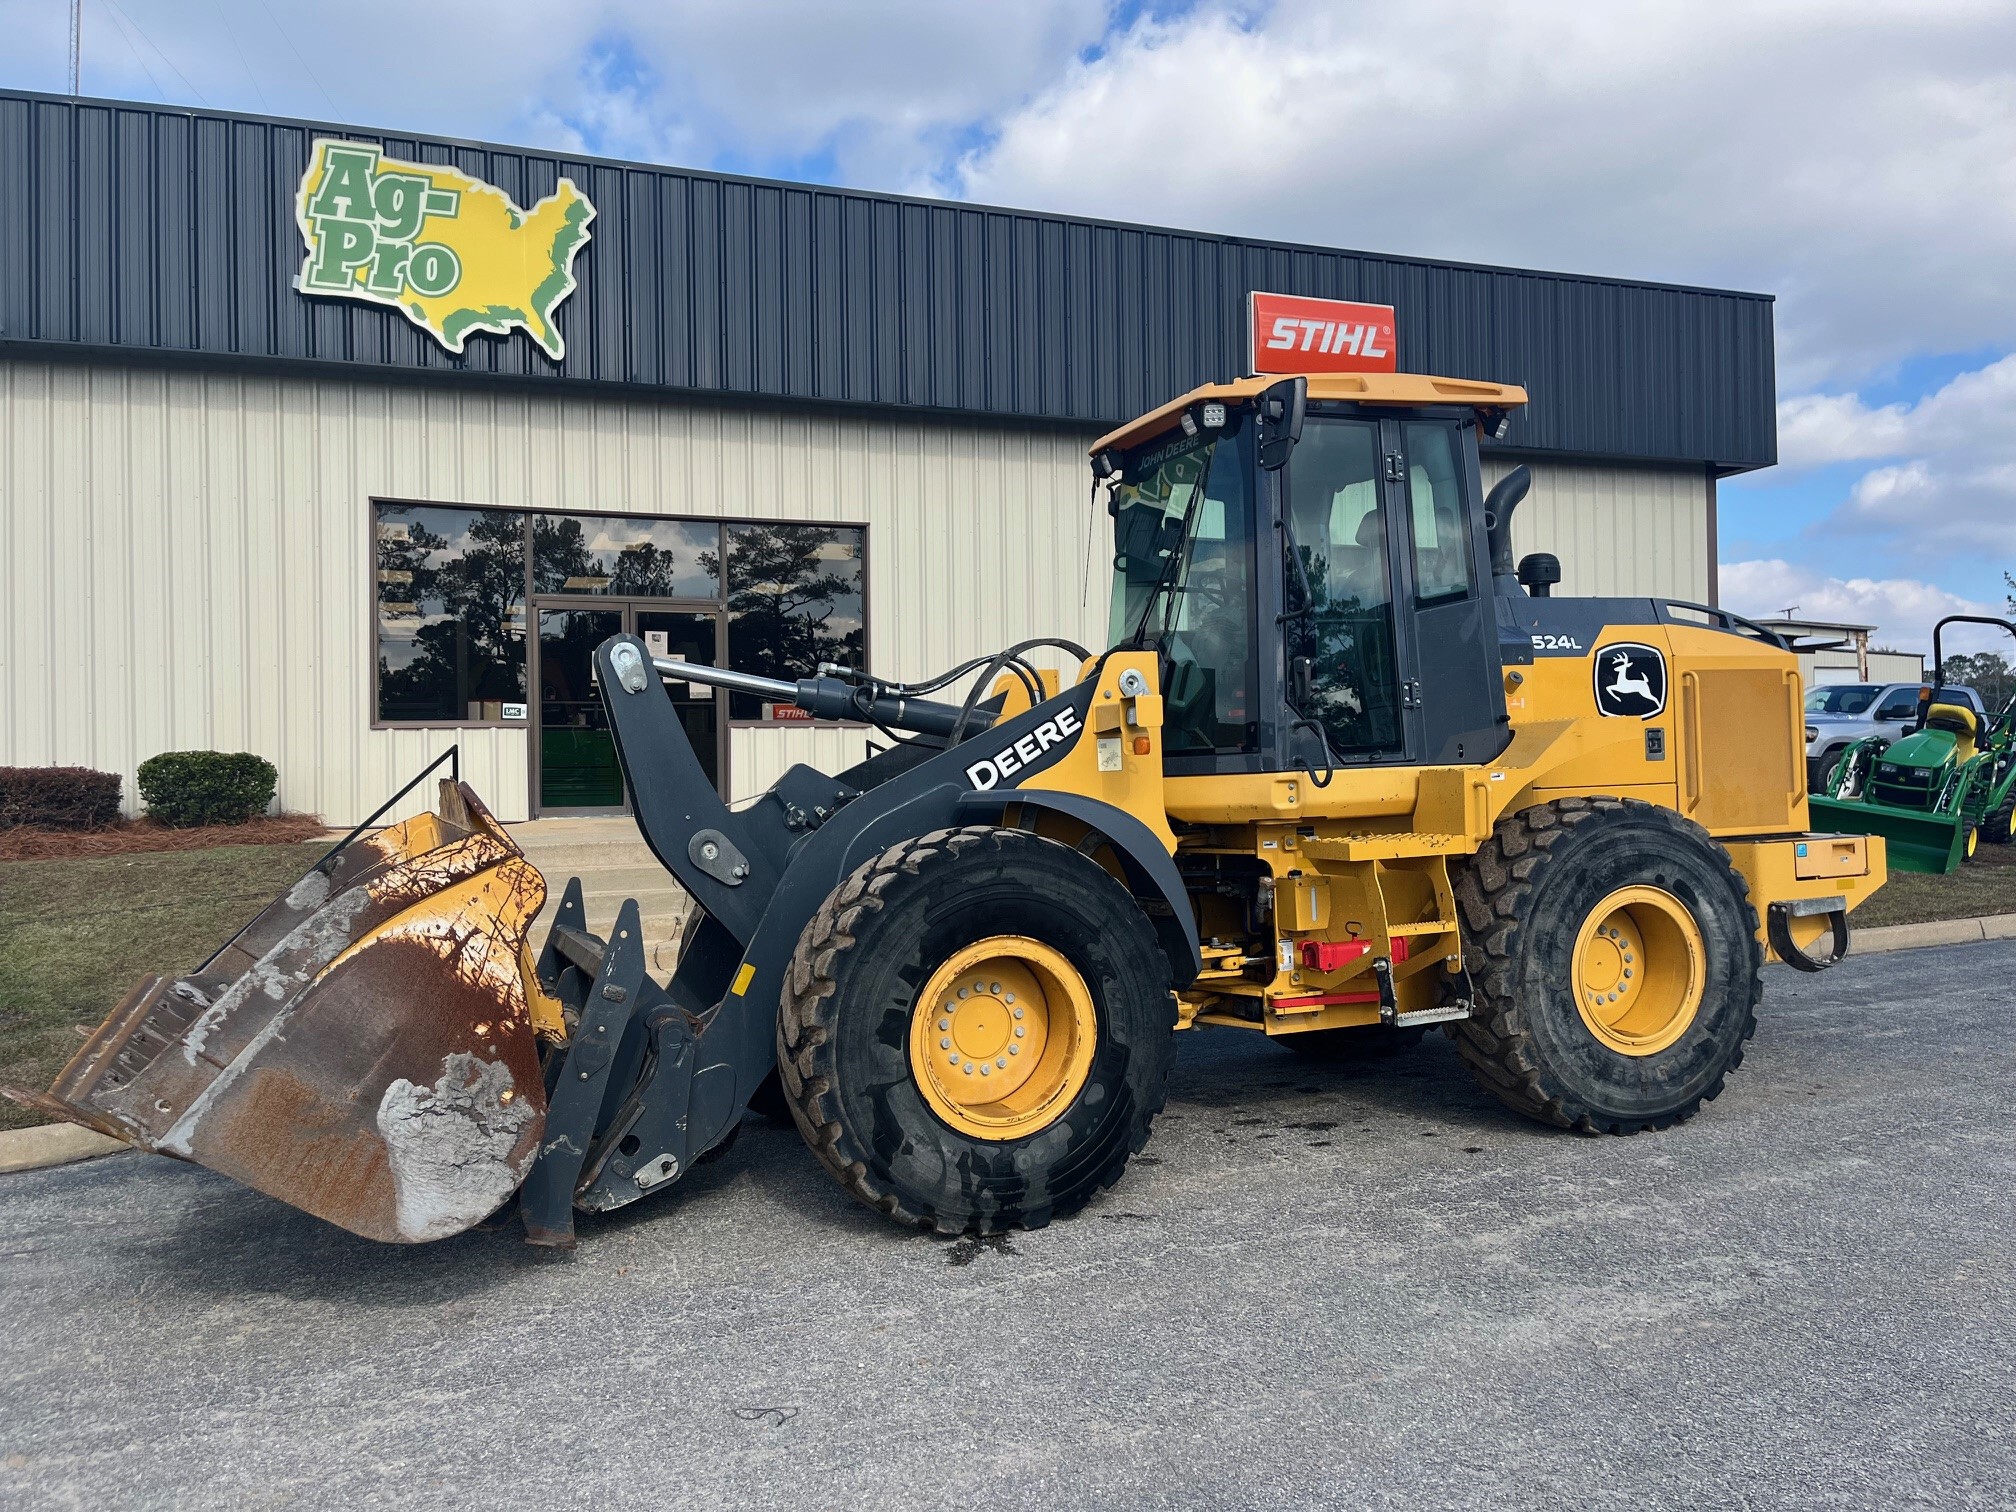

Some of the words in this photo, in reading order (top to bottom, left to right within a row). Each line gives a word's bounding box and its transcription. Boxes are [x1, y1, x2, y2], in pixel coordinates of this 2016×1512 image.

[308, 148, 459, 241] Ag-
[309, 217, 460, 296] Pro
[1266, 316, 1387, 358] STIHL
[1138, 449, 1164, 472] JOHN
[1165, 432, 1201, 460] DEERE
[1530, 634, 1583, 650] 524L
[776, 709, 811, 719] STIHL
[965, 705, 1083, 791] DEERE
